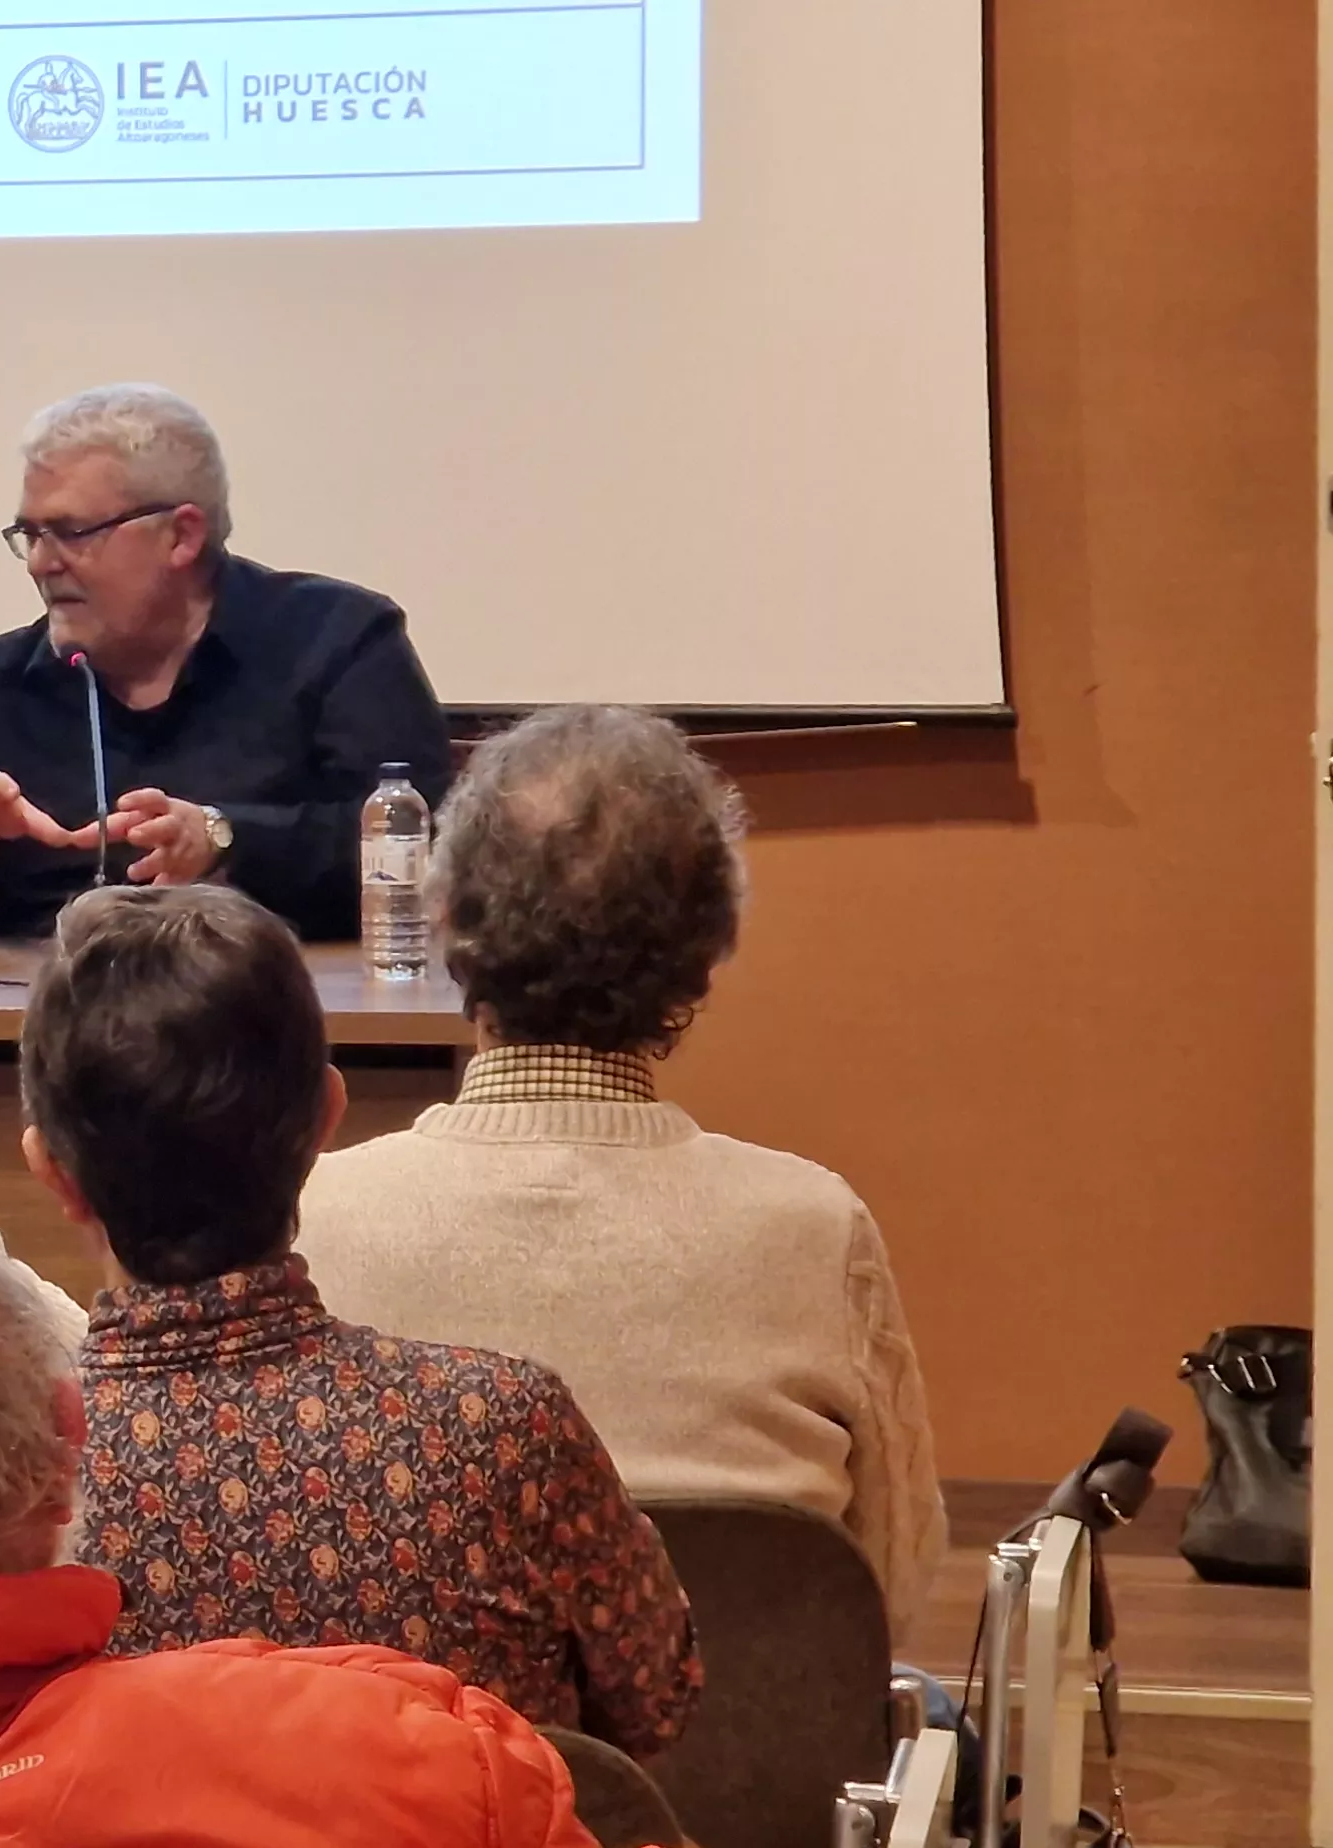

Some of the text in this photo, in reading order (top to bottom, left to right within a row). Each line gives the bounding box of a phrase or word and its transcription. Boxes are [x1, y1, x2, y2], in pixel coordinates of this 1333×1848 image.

[117, 60, 209, 100] IEA
[243, 65, 427, 98] DIPUTACIÓN
[243, 97, 426, 124] HUESCA
